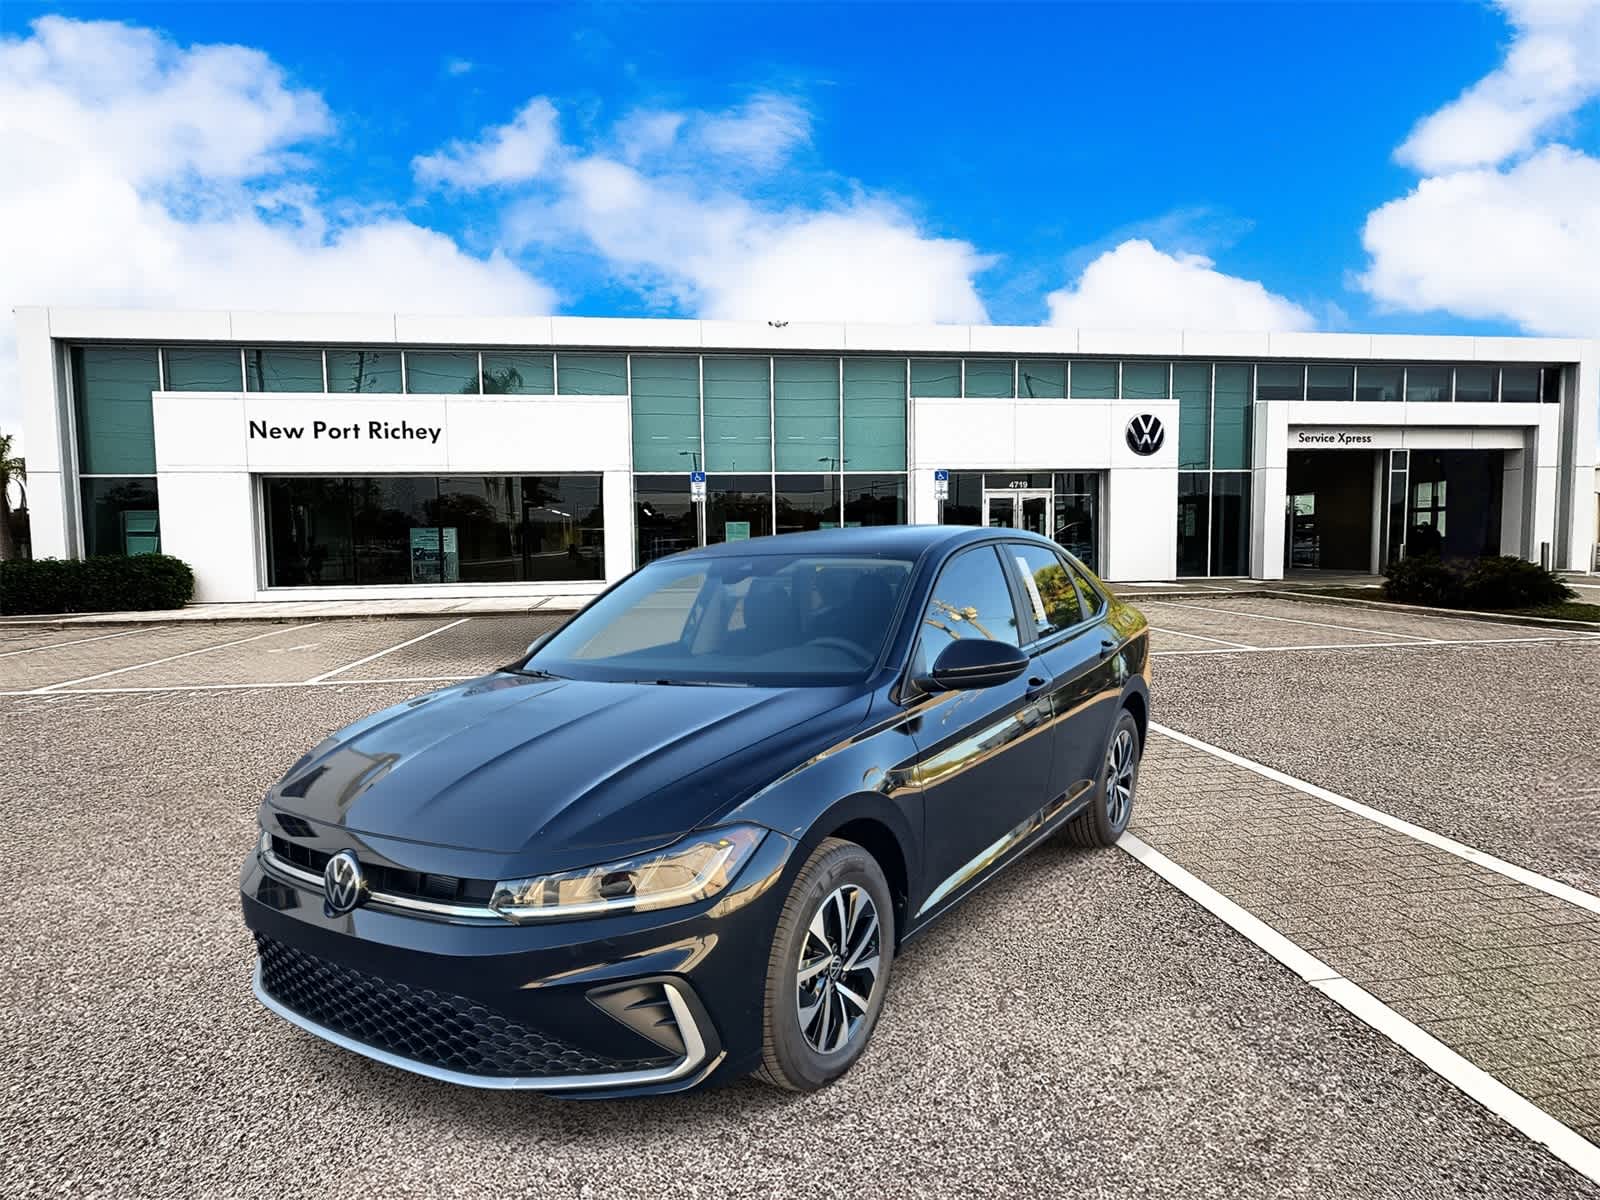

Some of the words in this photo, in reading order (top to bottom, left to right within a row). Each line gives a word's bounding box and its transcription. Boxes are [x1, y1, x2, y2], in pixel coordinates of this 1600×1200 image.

[249, 420, 304, 439] New
[313, 420, 361, 439] Port
[368, 420, 442, 444] Richey
[1298, 432, 1335, 443] Service
[1337, 432, 1372, 445] Xpress
[1008, 480, 1028, 488] 4719
